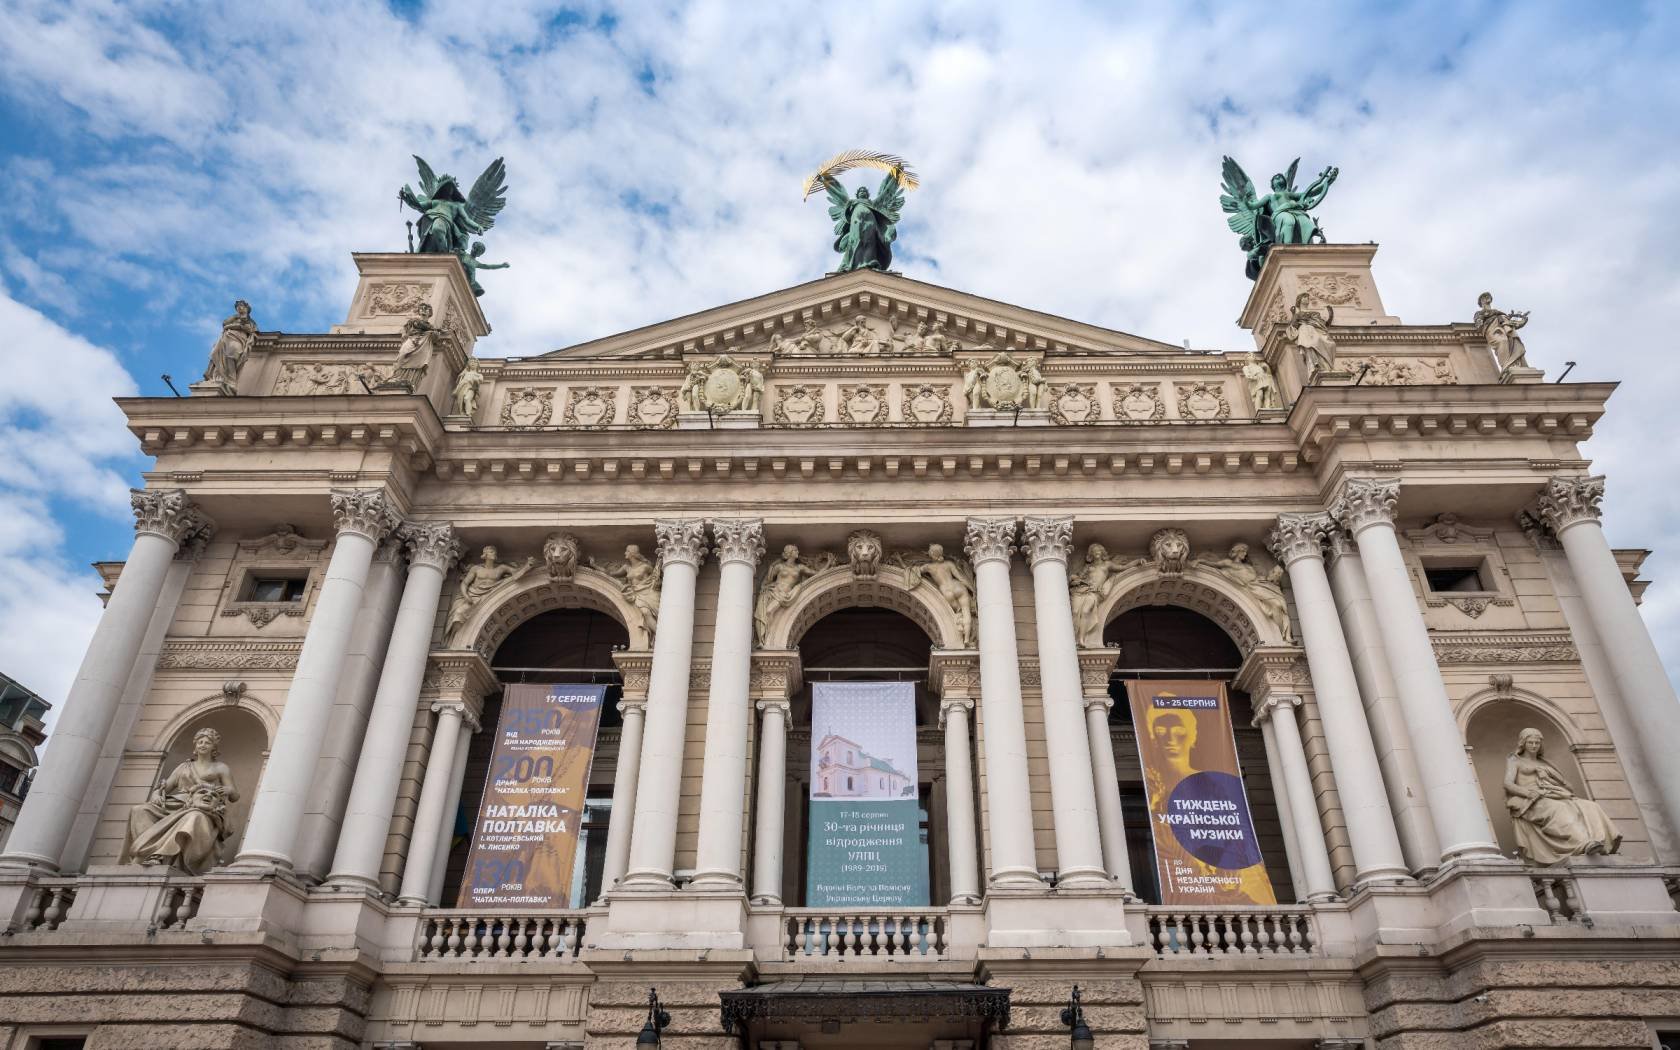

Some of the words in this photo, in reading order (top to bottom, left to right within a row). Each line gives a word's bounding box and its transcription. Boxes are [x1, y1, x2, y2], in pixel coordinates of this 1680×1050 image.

[546, 695, 557, 703] 17
[558, 695, 597, 703] СЕРПНЯ
[1182, 699, 1217, 707] СЕРПНЯ
[493, 755, 554, 783] 200
[1173, 799, 1237, 812] ТИЖДЕНЬ
[486, 805, 559, 818] НАТАЛКА
[1158, 811, 1241, 825] УКРАЇНСЬКОЇ
[482, 820, 567, 833] ПОЛТАВКА
[823, 821, 857, 832] 30-та
[859, 822, 905, 834] річниця
[486, 834, 544, 842] КОТЛЯРЕВСЬКИЙ
[1189, 828, 1244, 840] МУЗИКИ
[825, 837, 903, 848] відродження
[1175, 867, 1193, 876] ДНЯ
[1176, 876, 1242, 885] НЕЗАЛЕЖНОСТІ
[501, 883, 523, 891] РОКІВ
[1179, 885, 1215, 894] УКРАЇНИ
